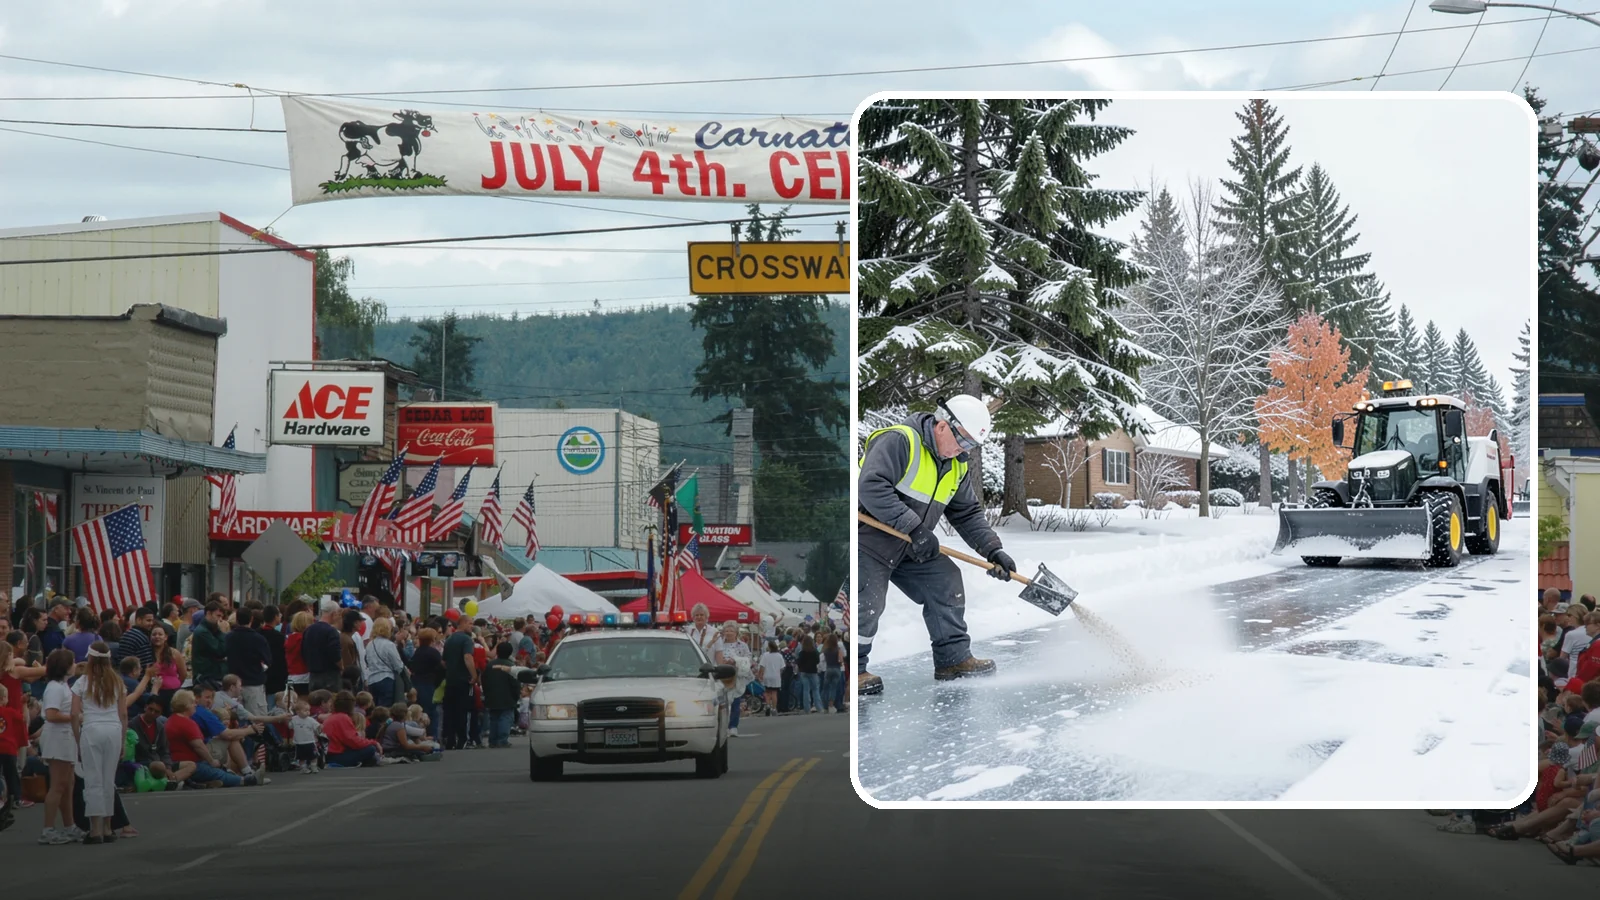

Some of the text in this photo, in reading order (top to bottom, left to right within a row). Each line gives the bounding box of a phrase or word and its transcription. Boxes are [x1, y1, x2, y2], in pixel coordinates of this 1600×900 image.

[481, 140, 605, 192] JULY
[632, 150, 746, 198] 4th.
[697, 254, 850, 280] CROSSWA
[282, 380, 373, 420] ACE
[406, 409, 452, 422] CEDAR
[283, 421, 371, 436] Hardware
[416, 428, 477, 447] Coca-Cola
[353, 466, 385, 480] Simpl
[83, 484, 155, 495] St. Vincent de Paul
[688, 526, 742, 535] CRNATION
[698, 535, 730, 543] GLASS
